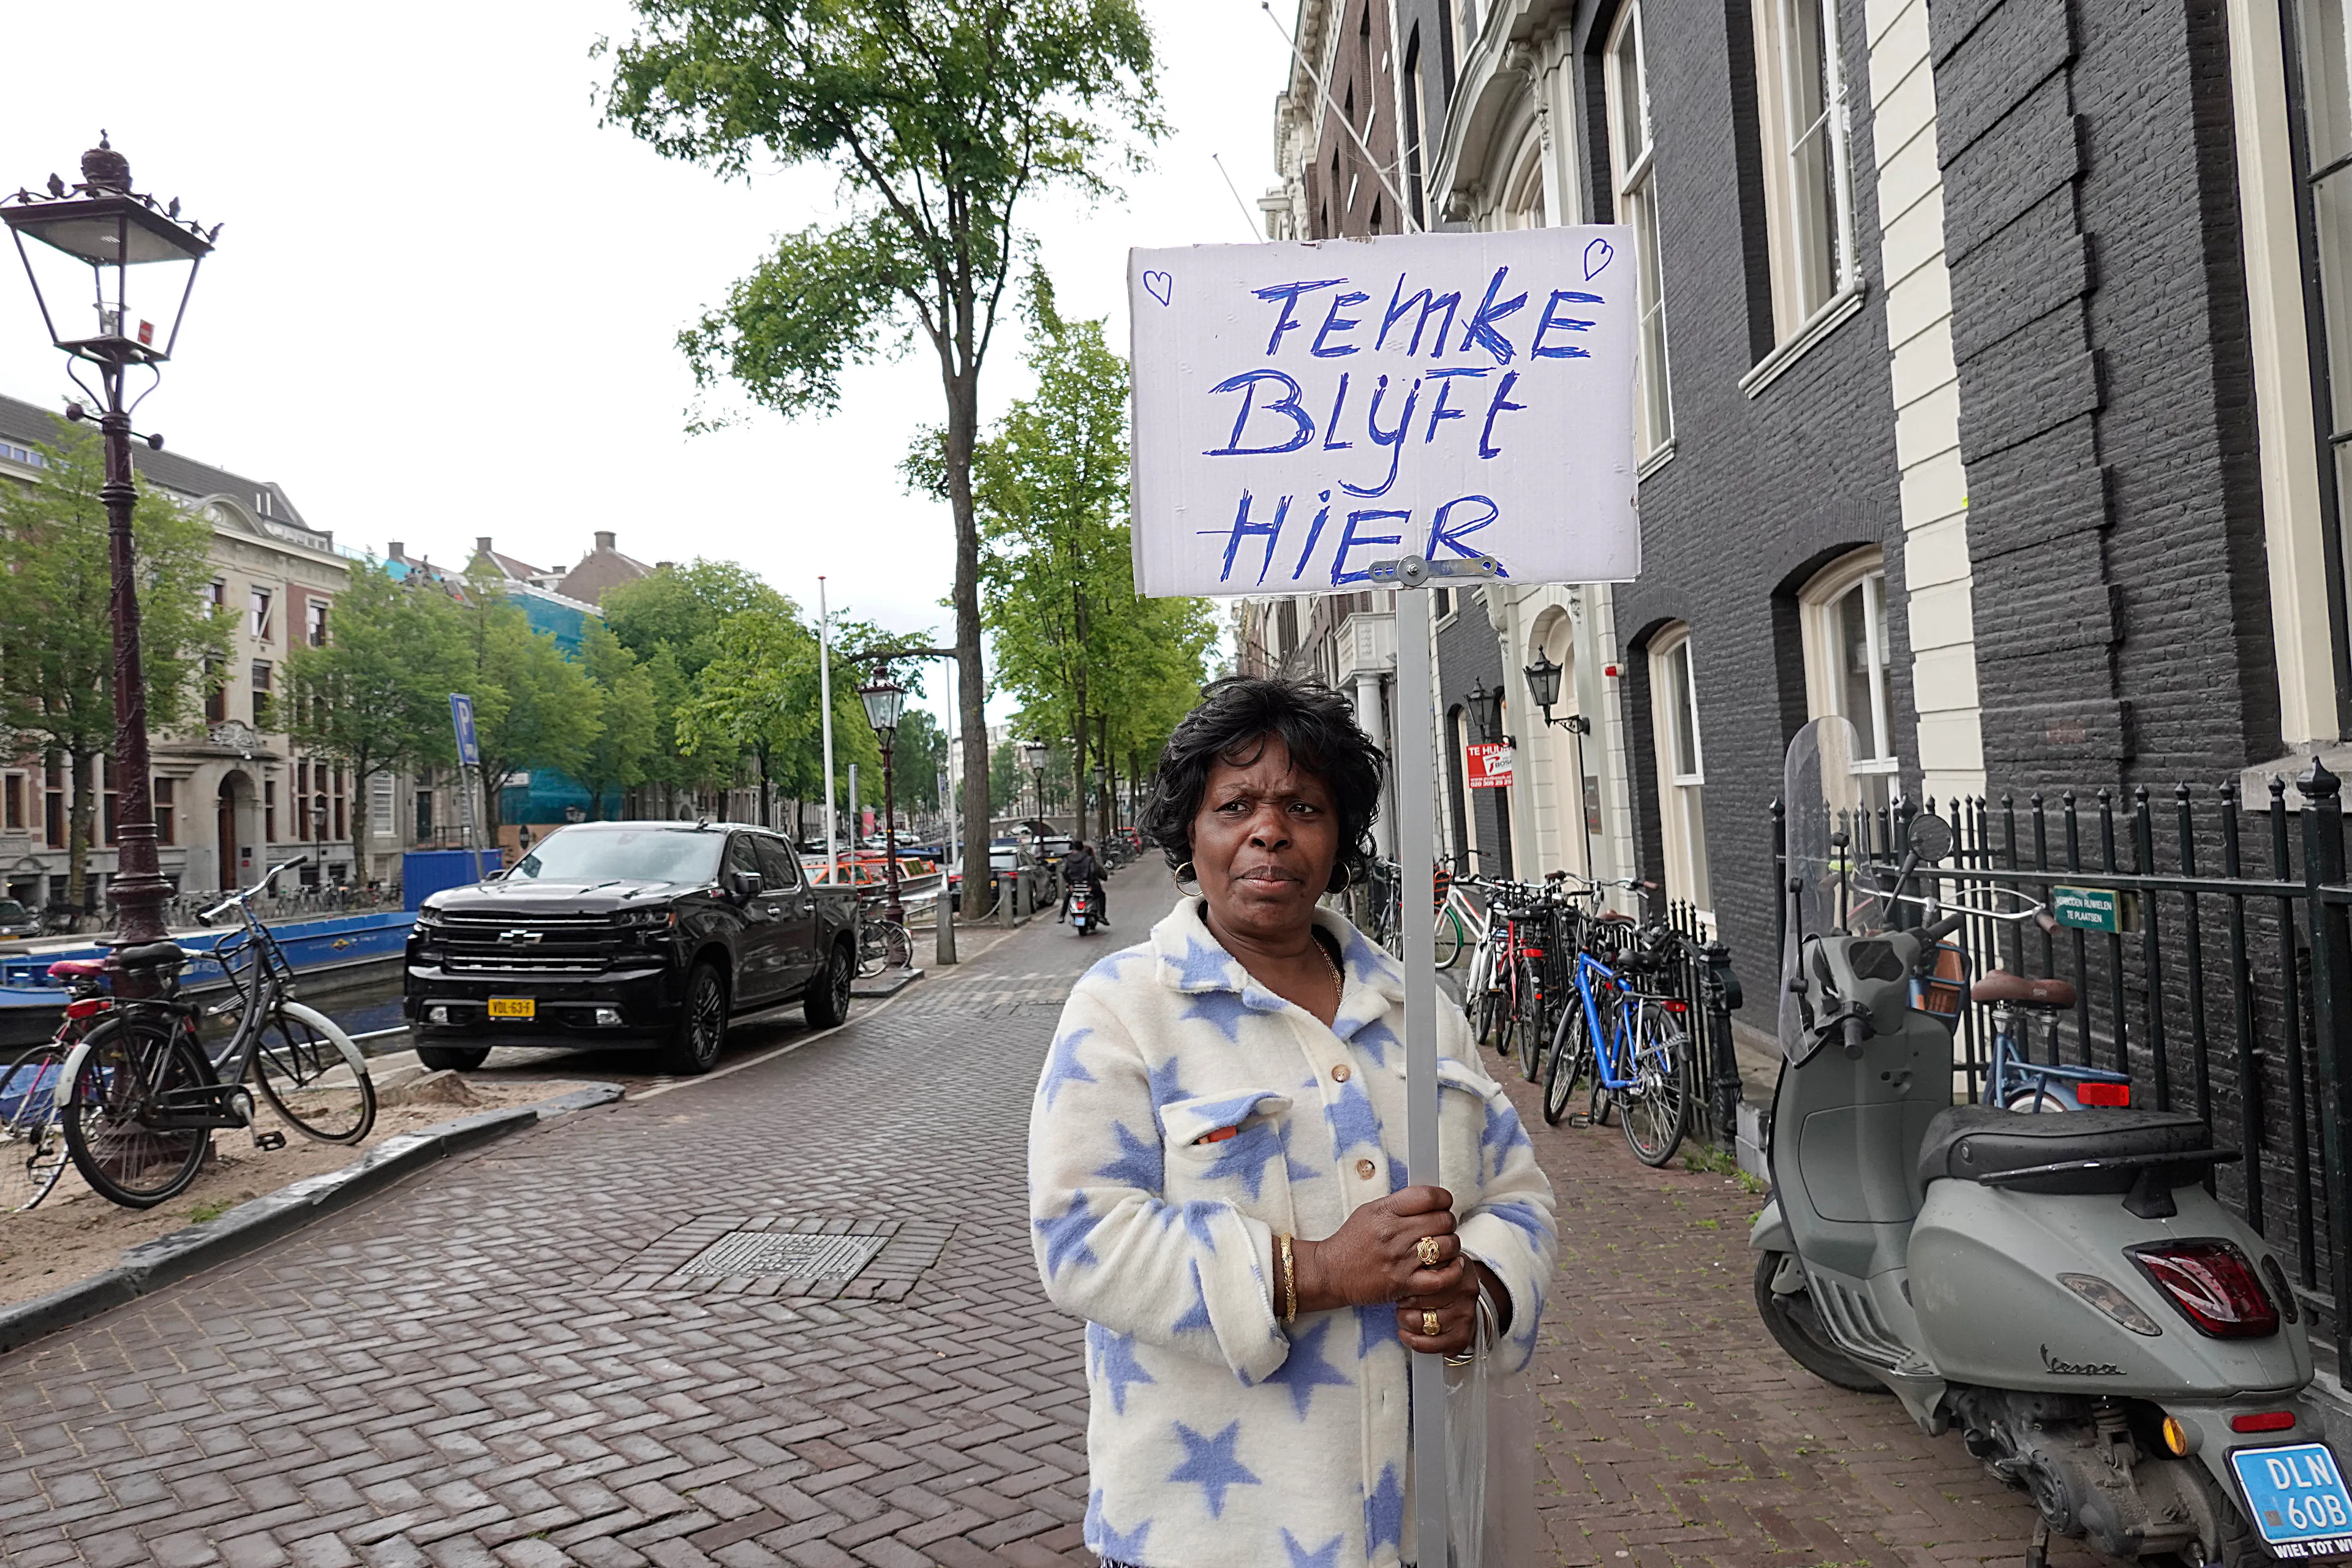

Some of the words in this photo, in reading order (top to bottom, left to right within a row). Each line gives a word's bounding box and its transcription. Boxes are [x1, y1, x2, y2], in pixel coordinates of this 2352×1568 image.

[458, 701, 470, 736] P
[1468, 747, 1480, 756] TE
[2067, 910, 2074, 919] TE
[2074, 911, 2103, 923] PLAATSEN
[2039, 1343, 2127, 1376] Vespa
[2266, 1454, 2333, 1490] DLN
[2288, 1494, 2347, 1529] 60B
[2273, 1543, 2309, 1559] WIEL
[2307, 1540, 2334, 1555] TOT
